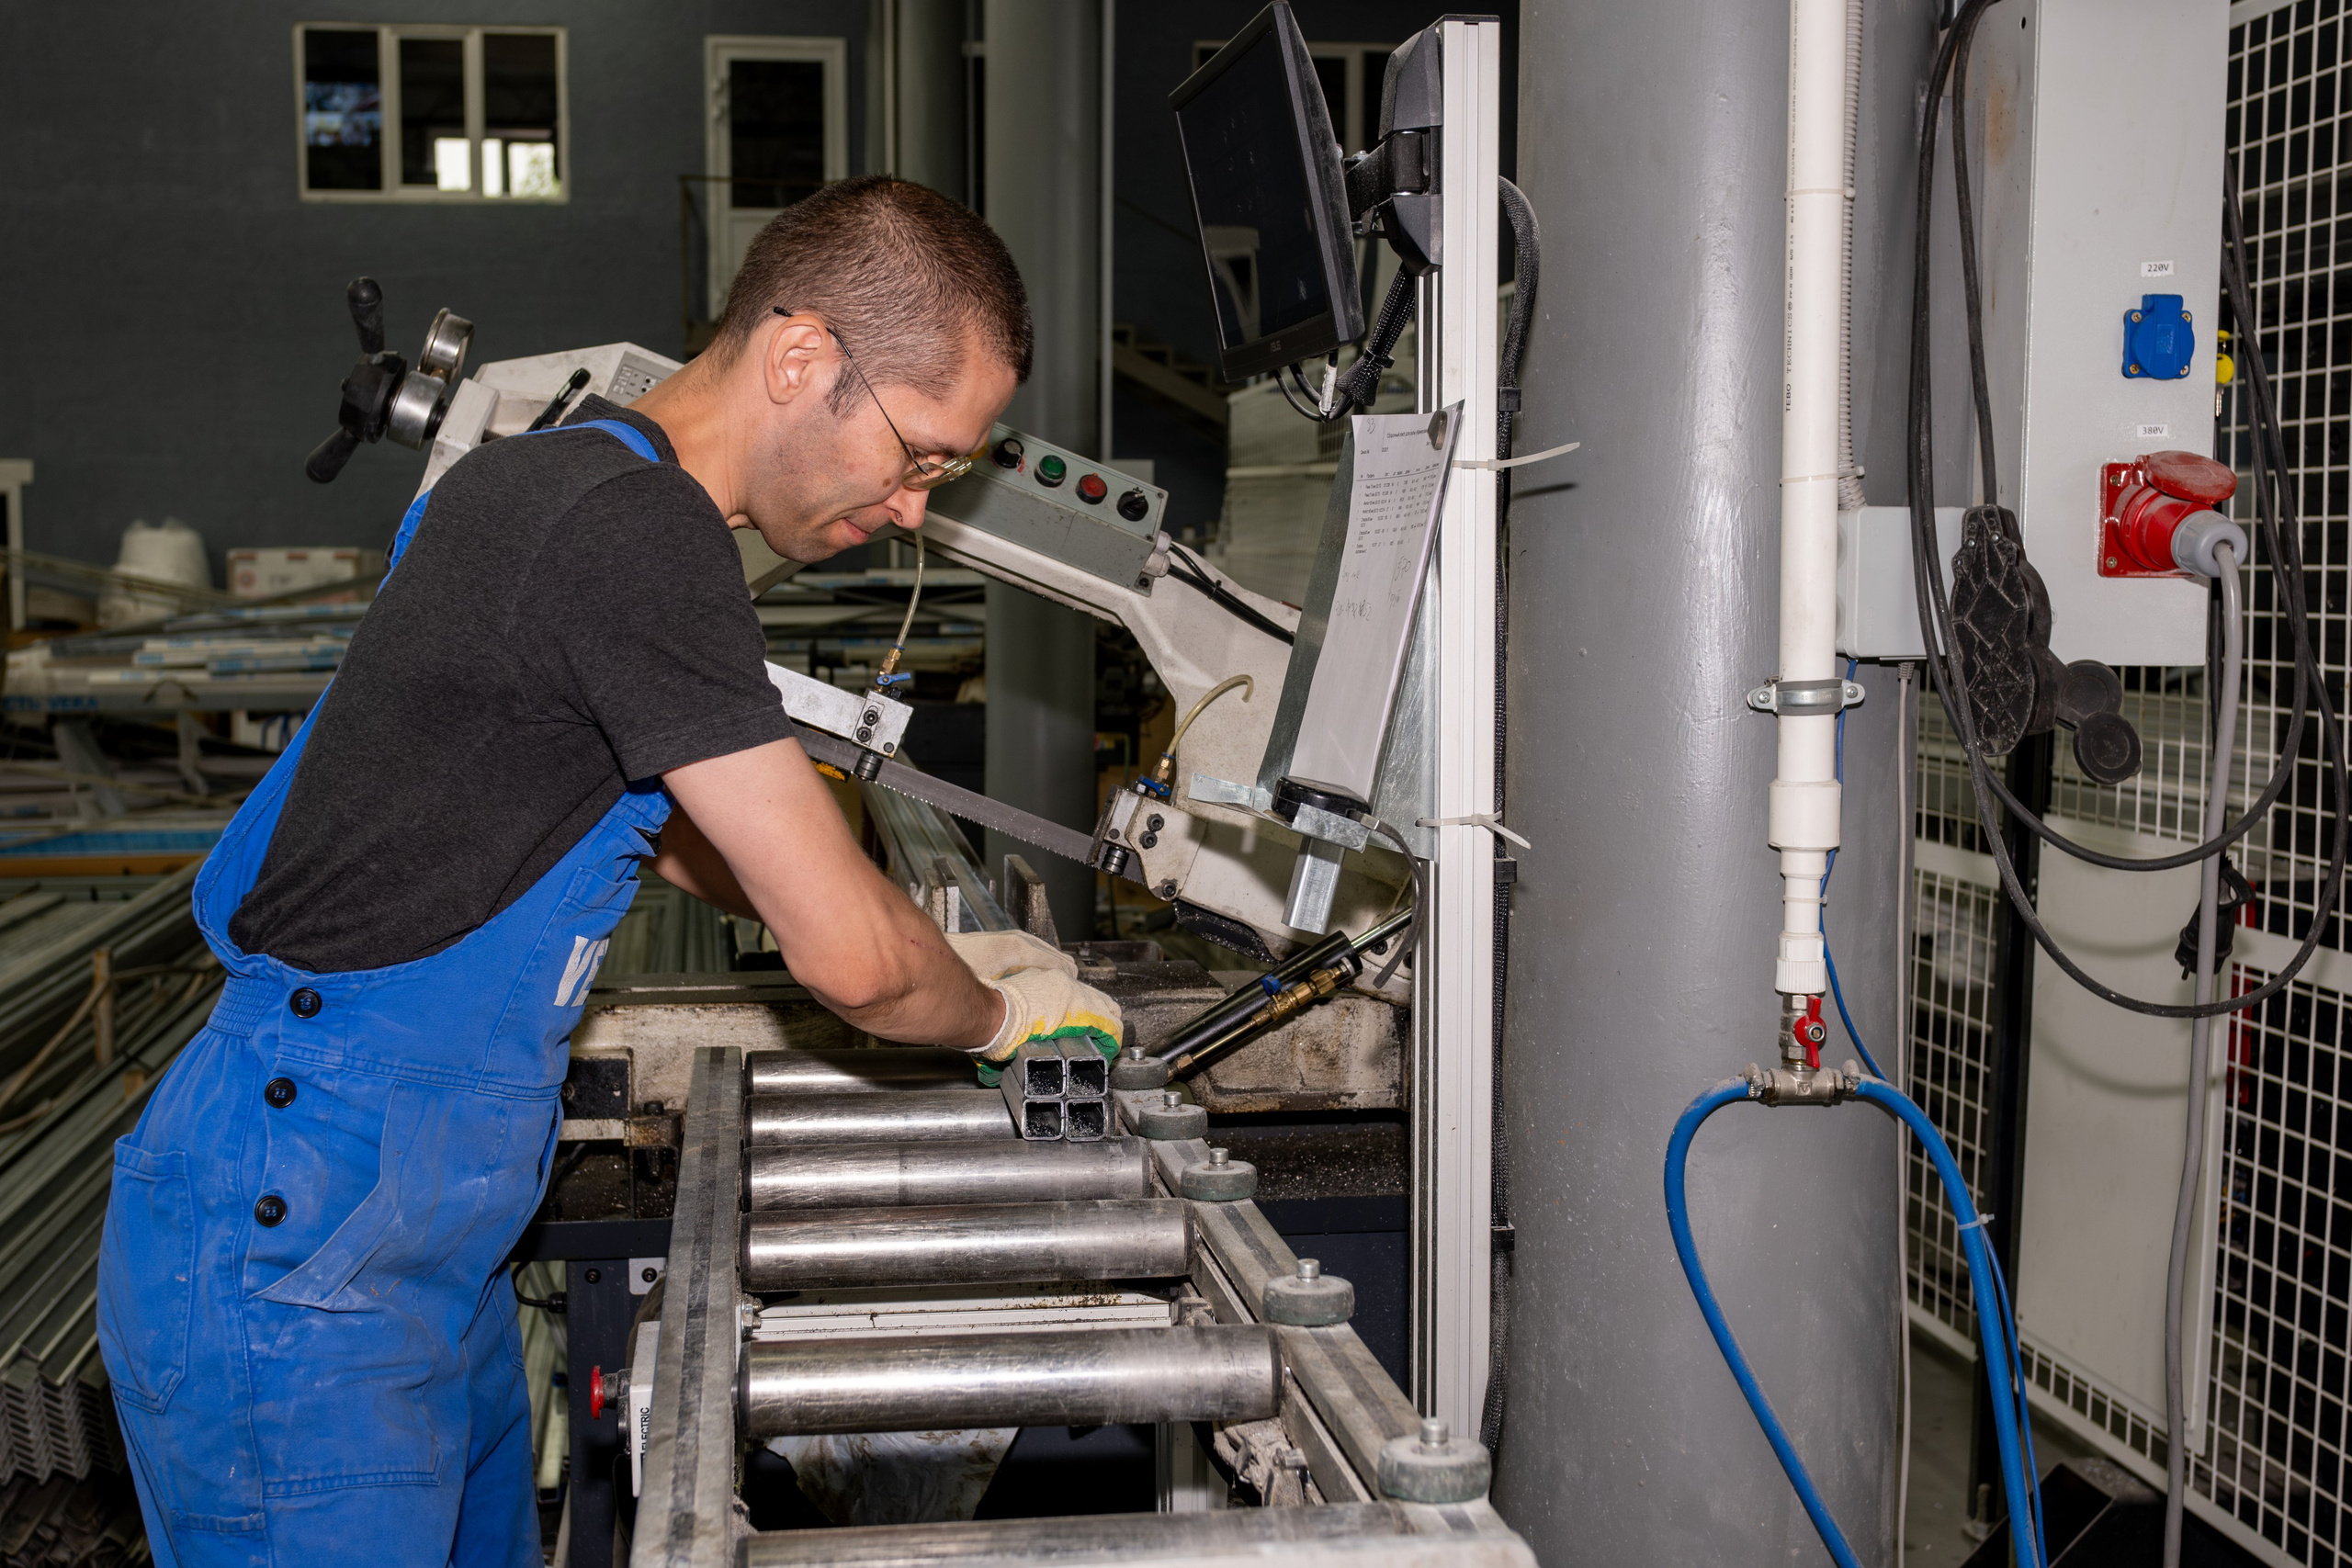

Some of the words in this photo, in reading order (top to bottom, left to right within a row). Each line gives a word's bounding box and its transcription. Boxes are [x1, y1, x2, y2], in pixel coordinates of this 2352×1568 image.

[2147, 263, 2169, 273] 220V
[2142, 425, 2164, 435] 380V
[553, 935, 610, 1008] VE
